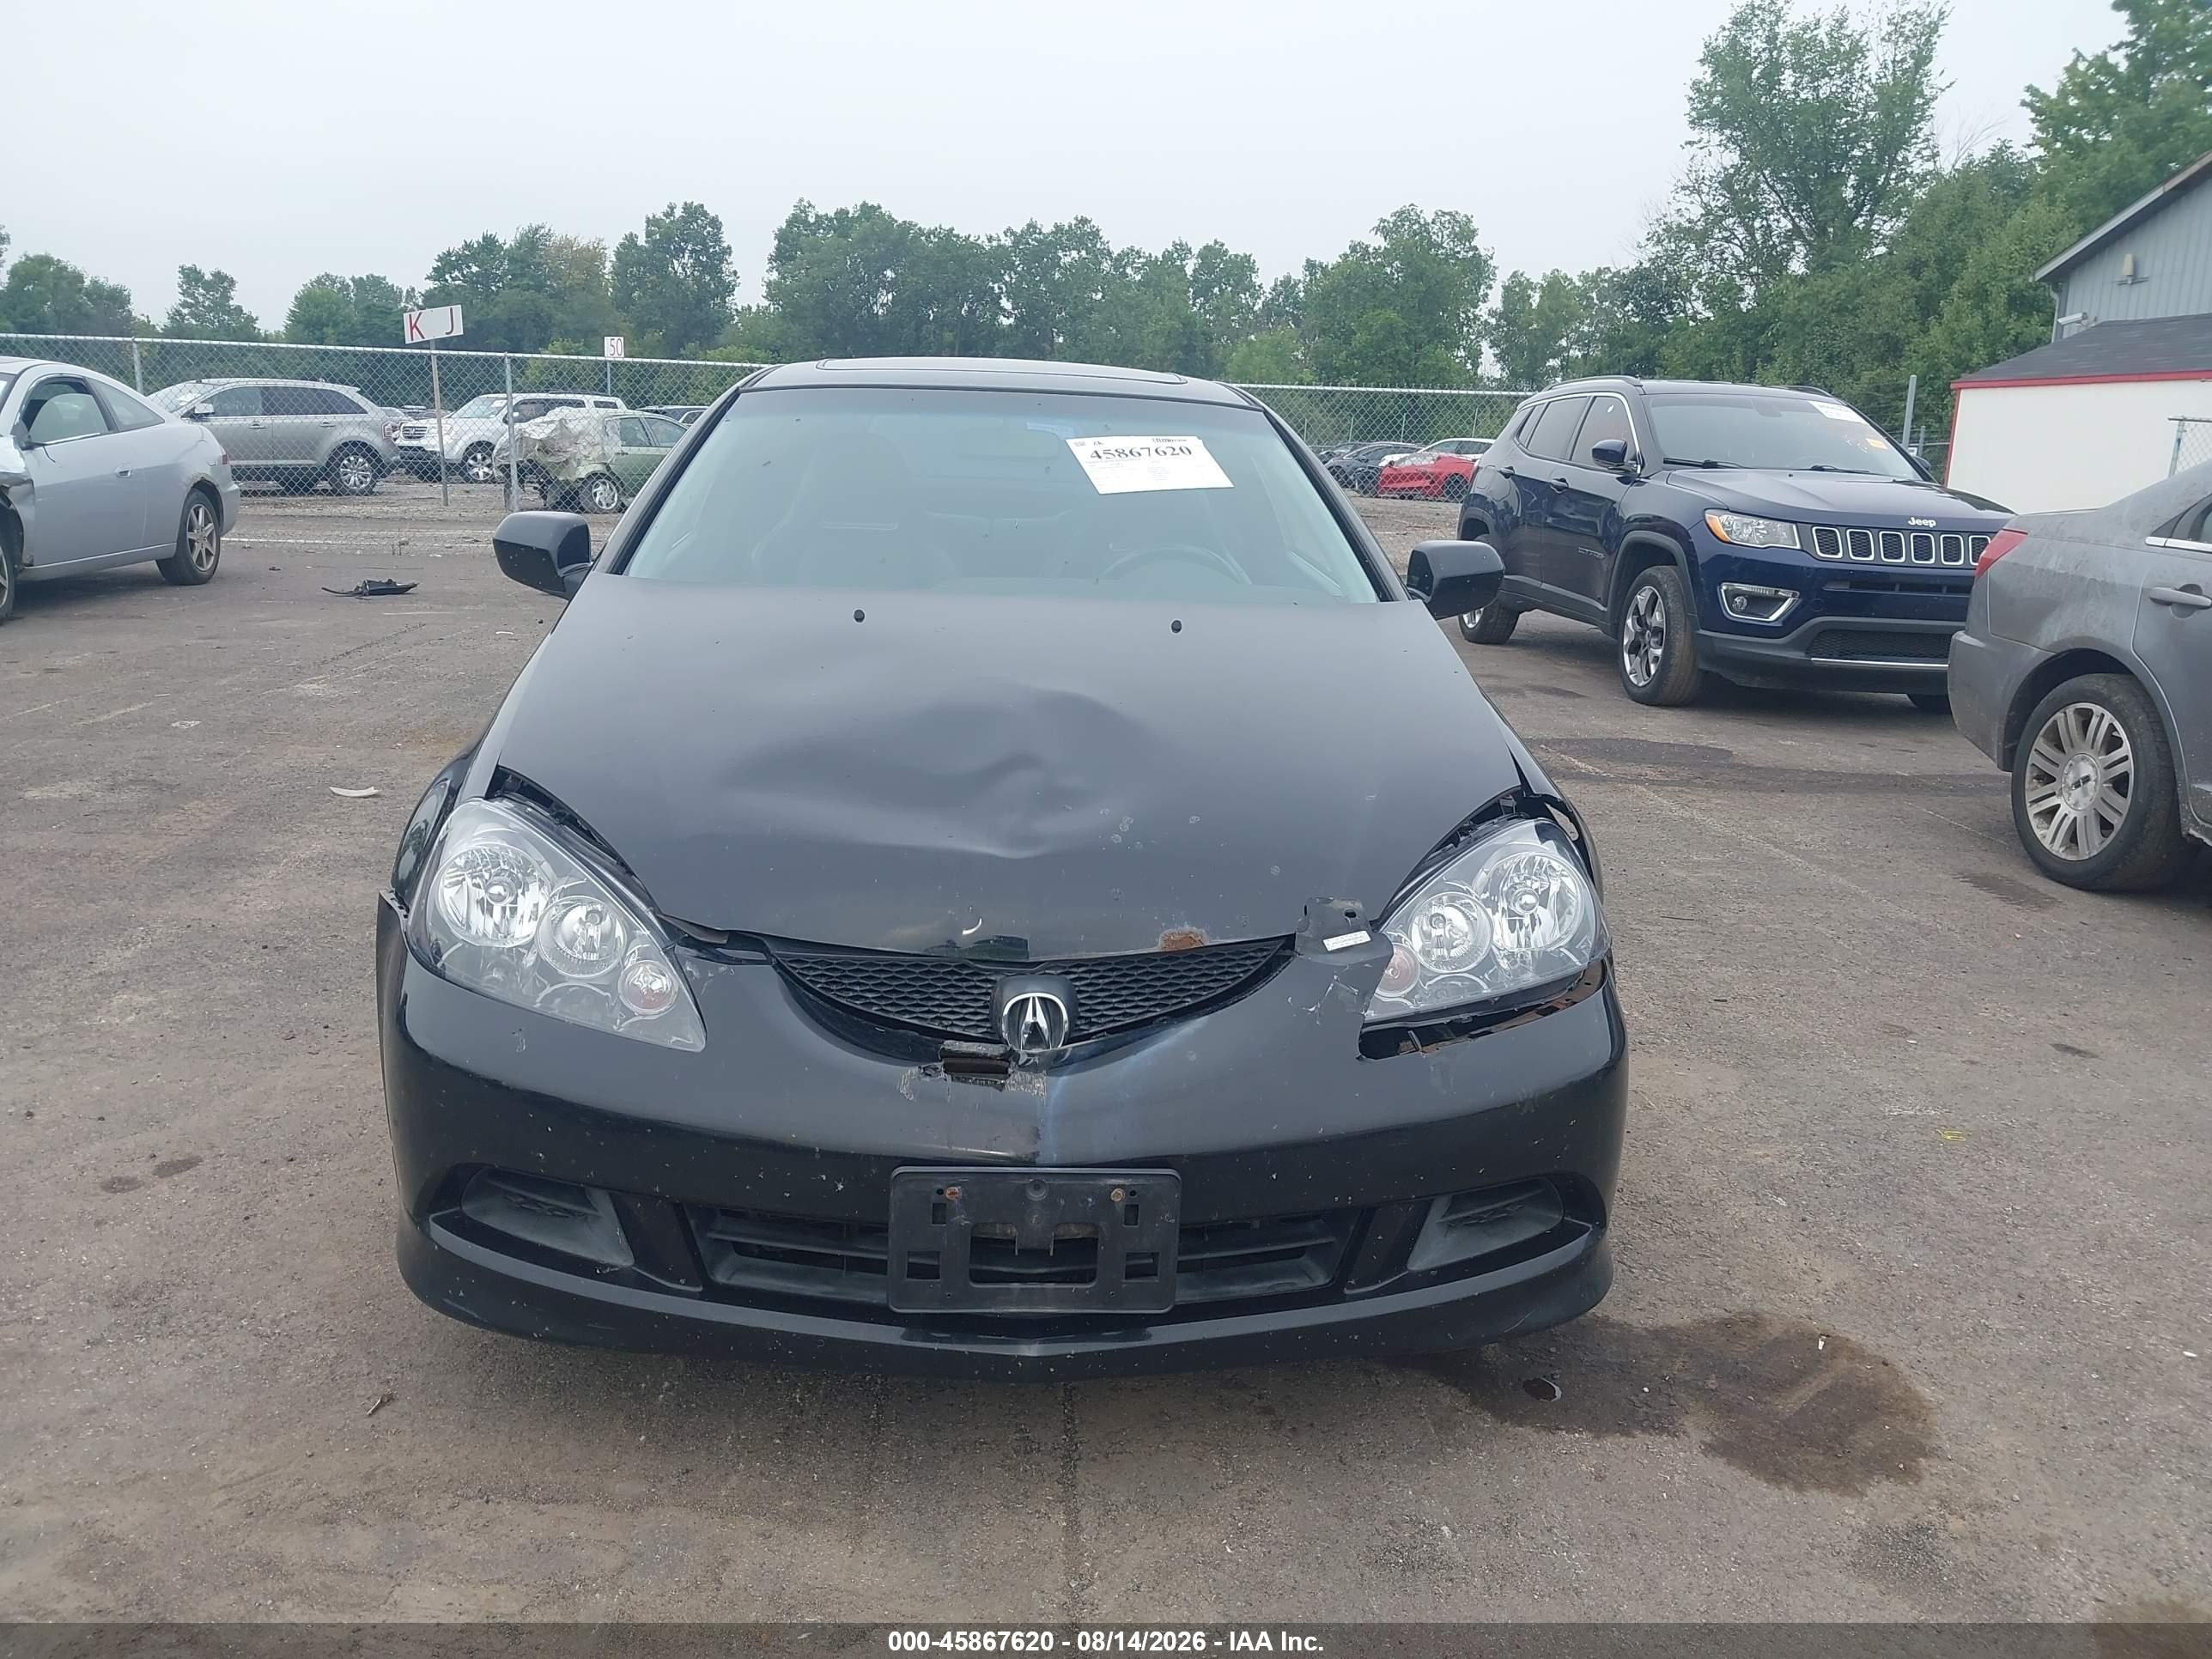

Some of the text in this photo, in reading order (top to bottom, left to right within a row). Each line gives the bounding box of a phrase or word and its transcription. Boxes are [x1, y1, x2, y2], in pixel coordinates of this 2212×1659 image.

[408, 307, 454, 341] K J
[610, 337, 623, 356] 50
[1090, 445, 1193, 460] 45867620
[1907, 516, 1936, 528] Jeep
